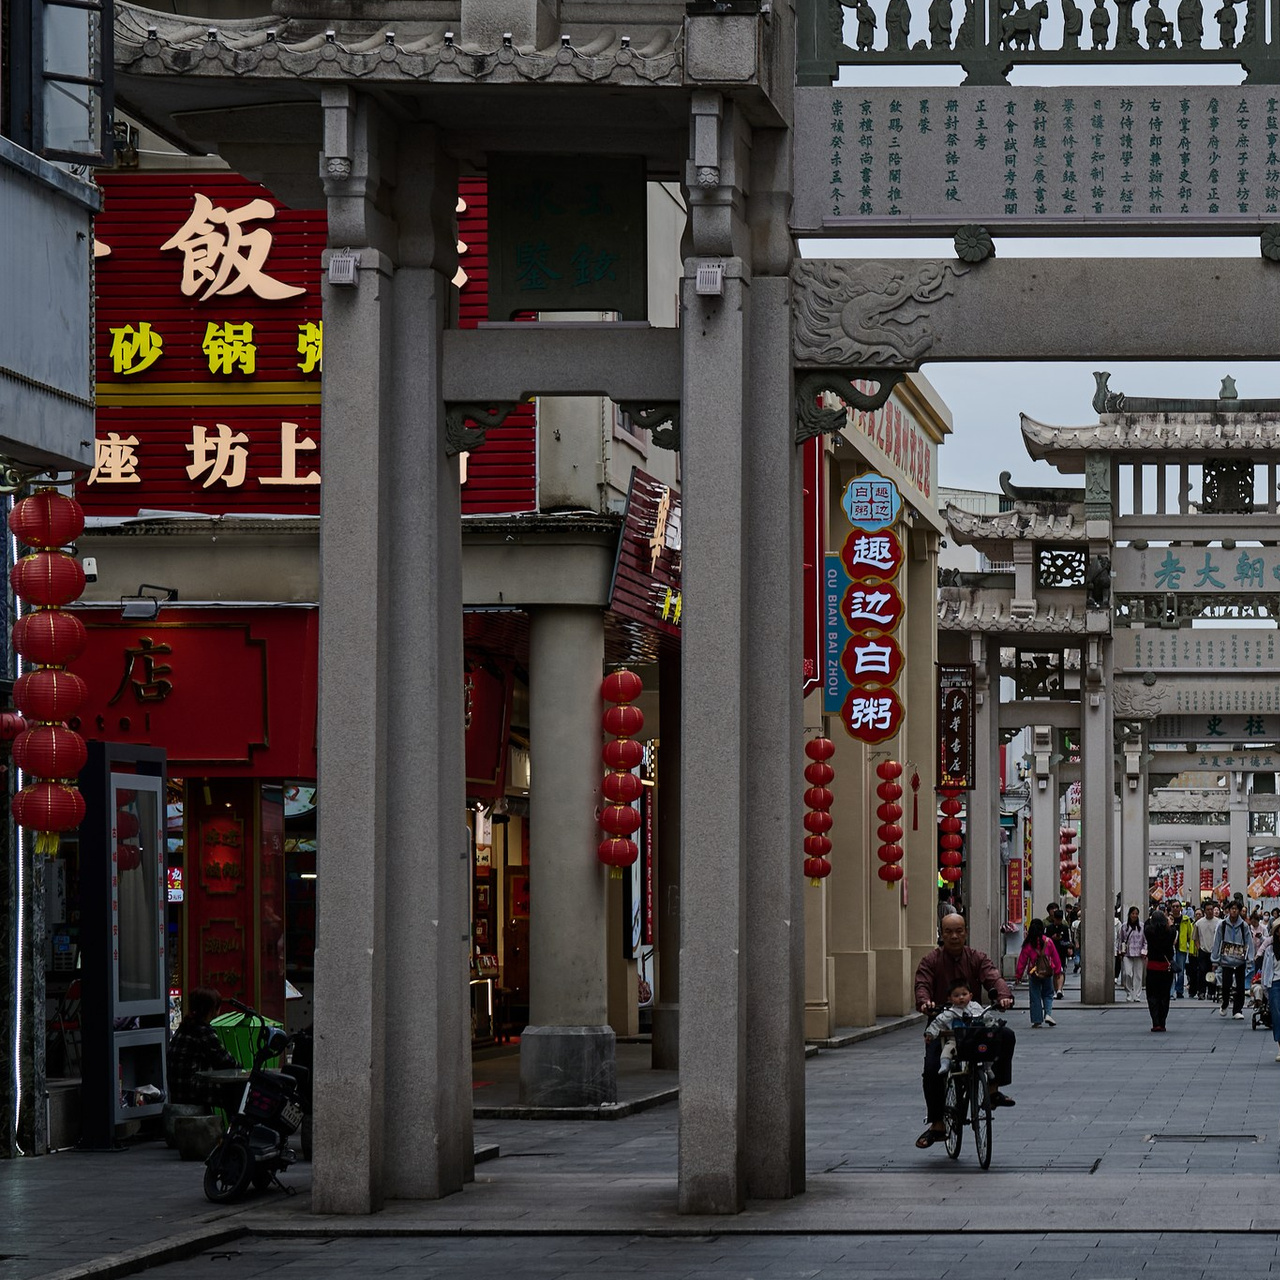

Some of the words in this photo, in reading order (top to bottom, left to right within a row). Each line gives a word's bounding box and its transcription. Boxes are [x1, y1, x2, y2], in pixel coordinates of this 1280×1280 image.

[974, 99, 988, 150] 正主考
[160, 193, 306, 301] 飯
[827, 568, 838, 588] QU
[827, 596, 838, 625] BIAN
[827, 632, 838, 653] BAI
[851, 535, 895, 730] 趣边白粥
[109, 636, 172, 705] 店
[827, 660, 838, 696] ZHOU
